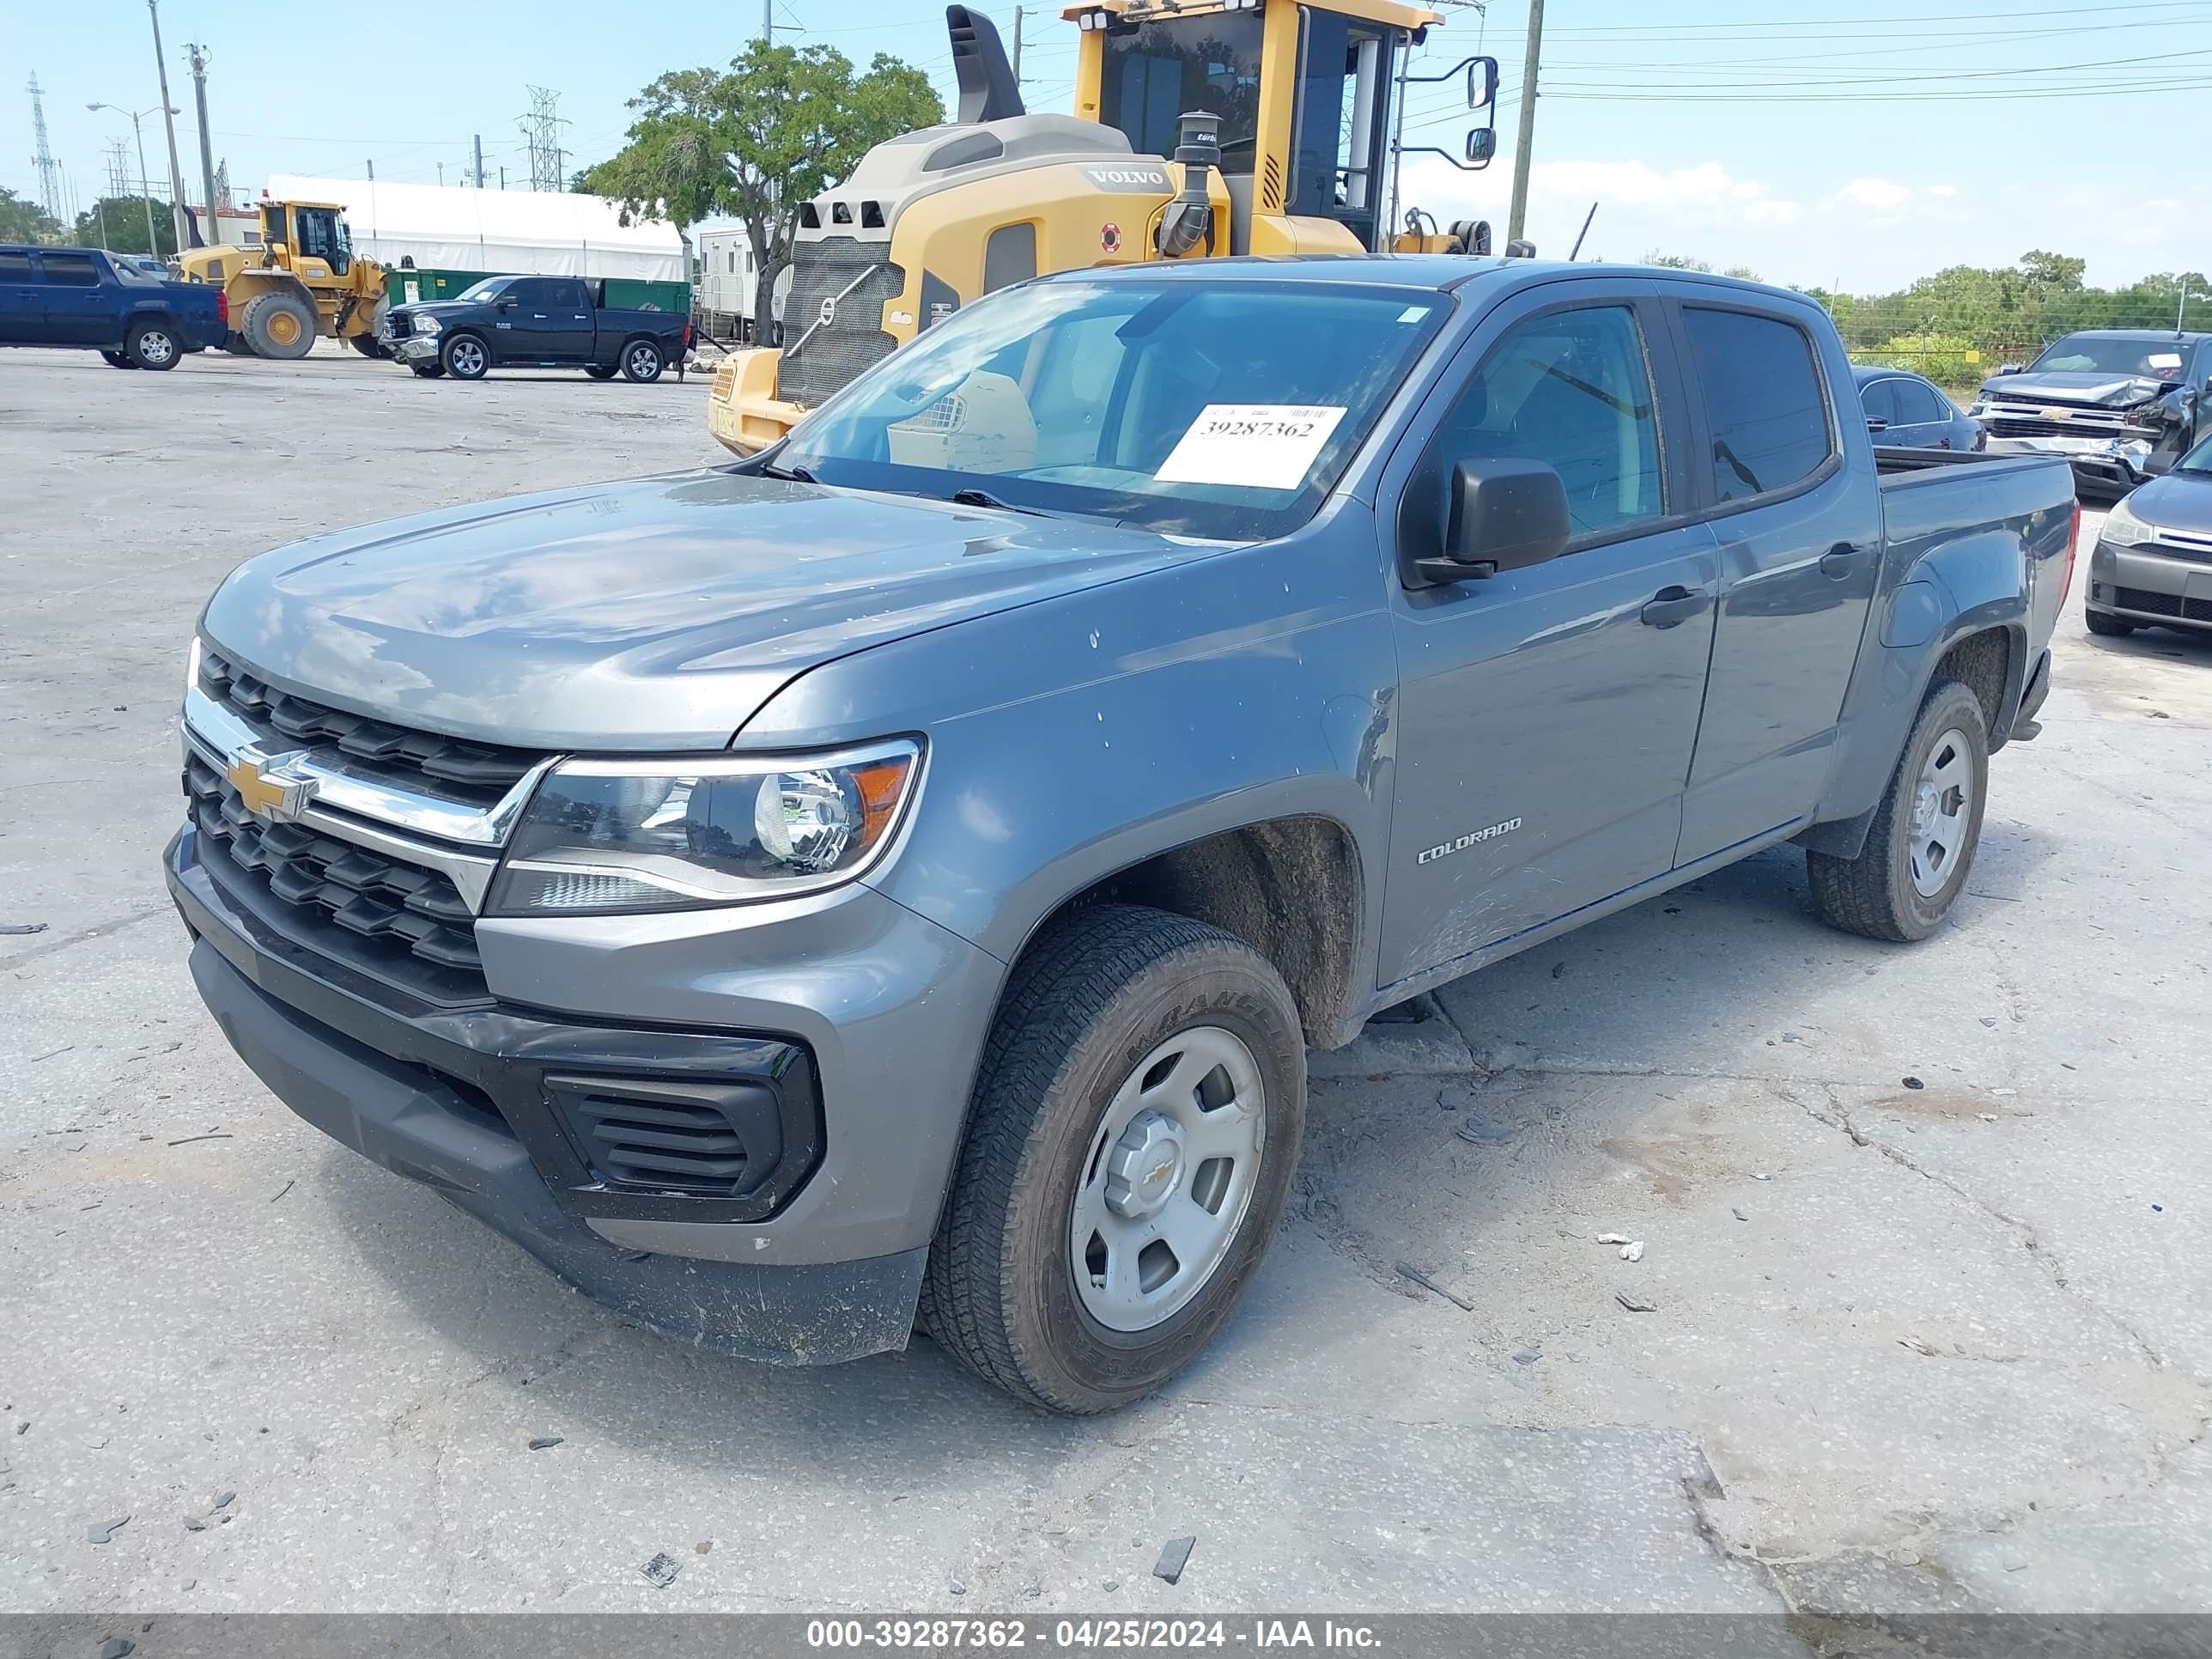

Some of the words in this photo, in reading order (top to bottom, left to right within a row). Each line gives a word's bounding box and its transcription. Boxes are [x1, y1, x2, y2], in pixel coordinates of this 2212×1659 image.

[1088, 171, 1164, 185] VOLVO
[1200, 422, 1315, 437] 39287362
[1418, 817, 1522, 865] COLORADO
